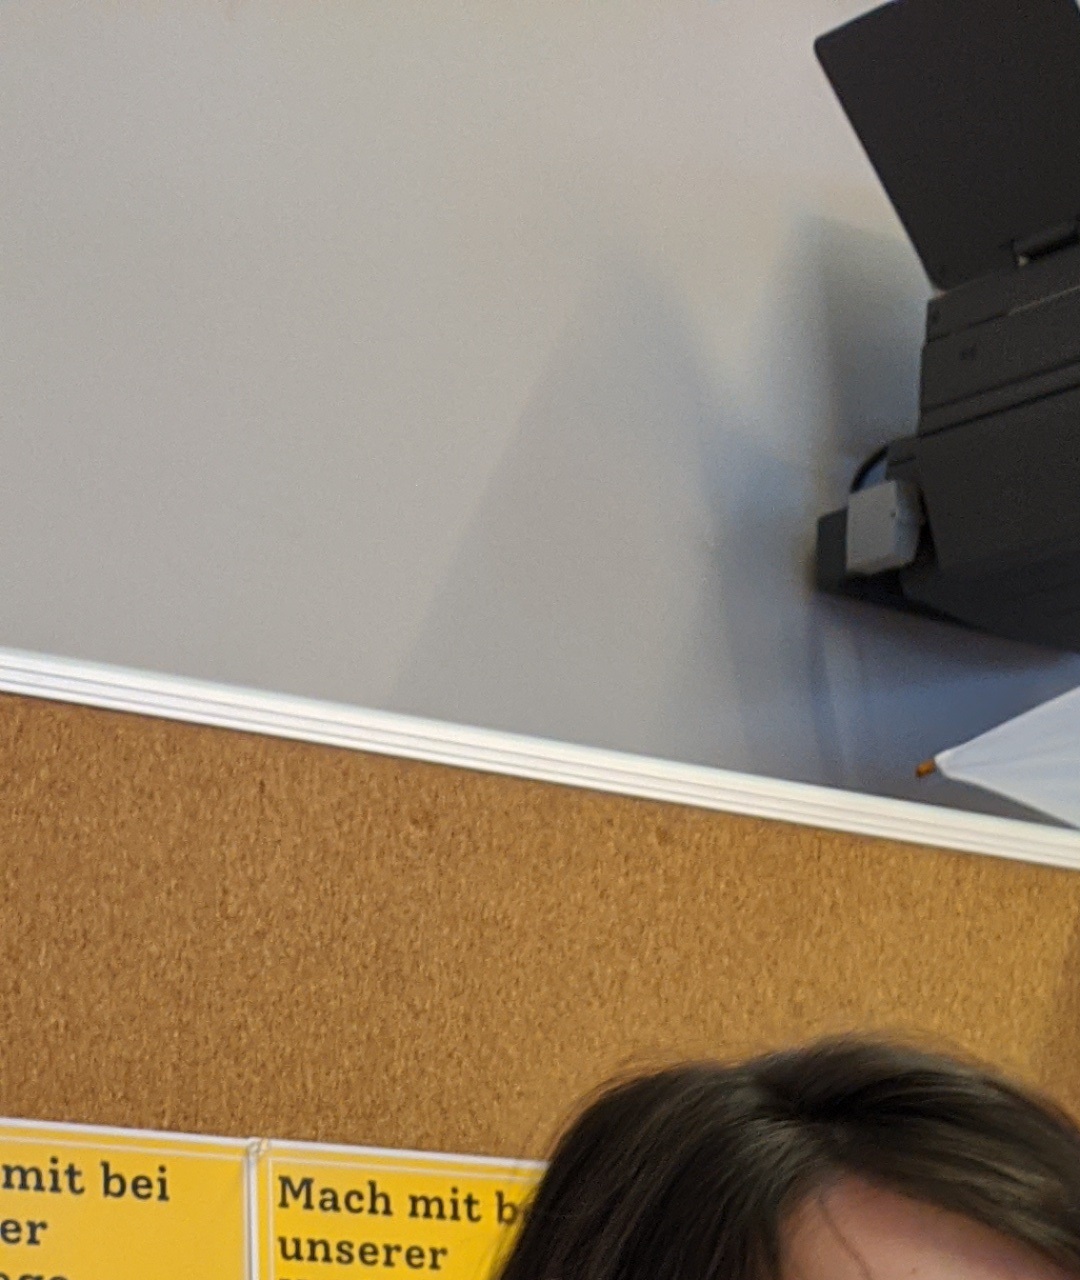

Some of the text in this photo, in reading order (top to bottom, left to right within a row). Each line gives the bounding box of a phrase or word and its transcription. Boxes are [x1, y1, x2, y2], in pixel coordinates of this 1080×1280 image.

[2, 1155, 170, 1202] mit bei
[278, 1174, 394, 1217] Mach
[408, 1186, 482, 1223] mit
[278, 1235, 449, 1271] unserer
